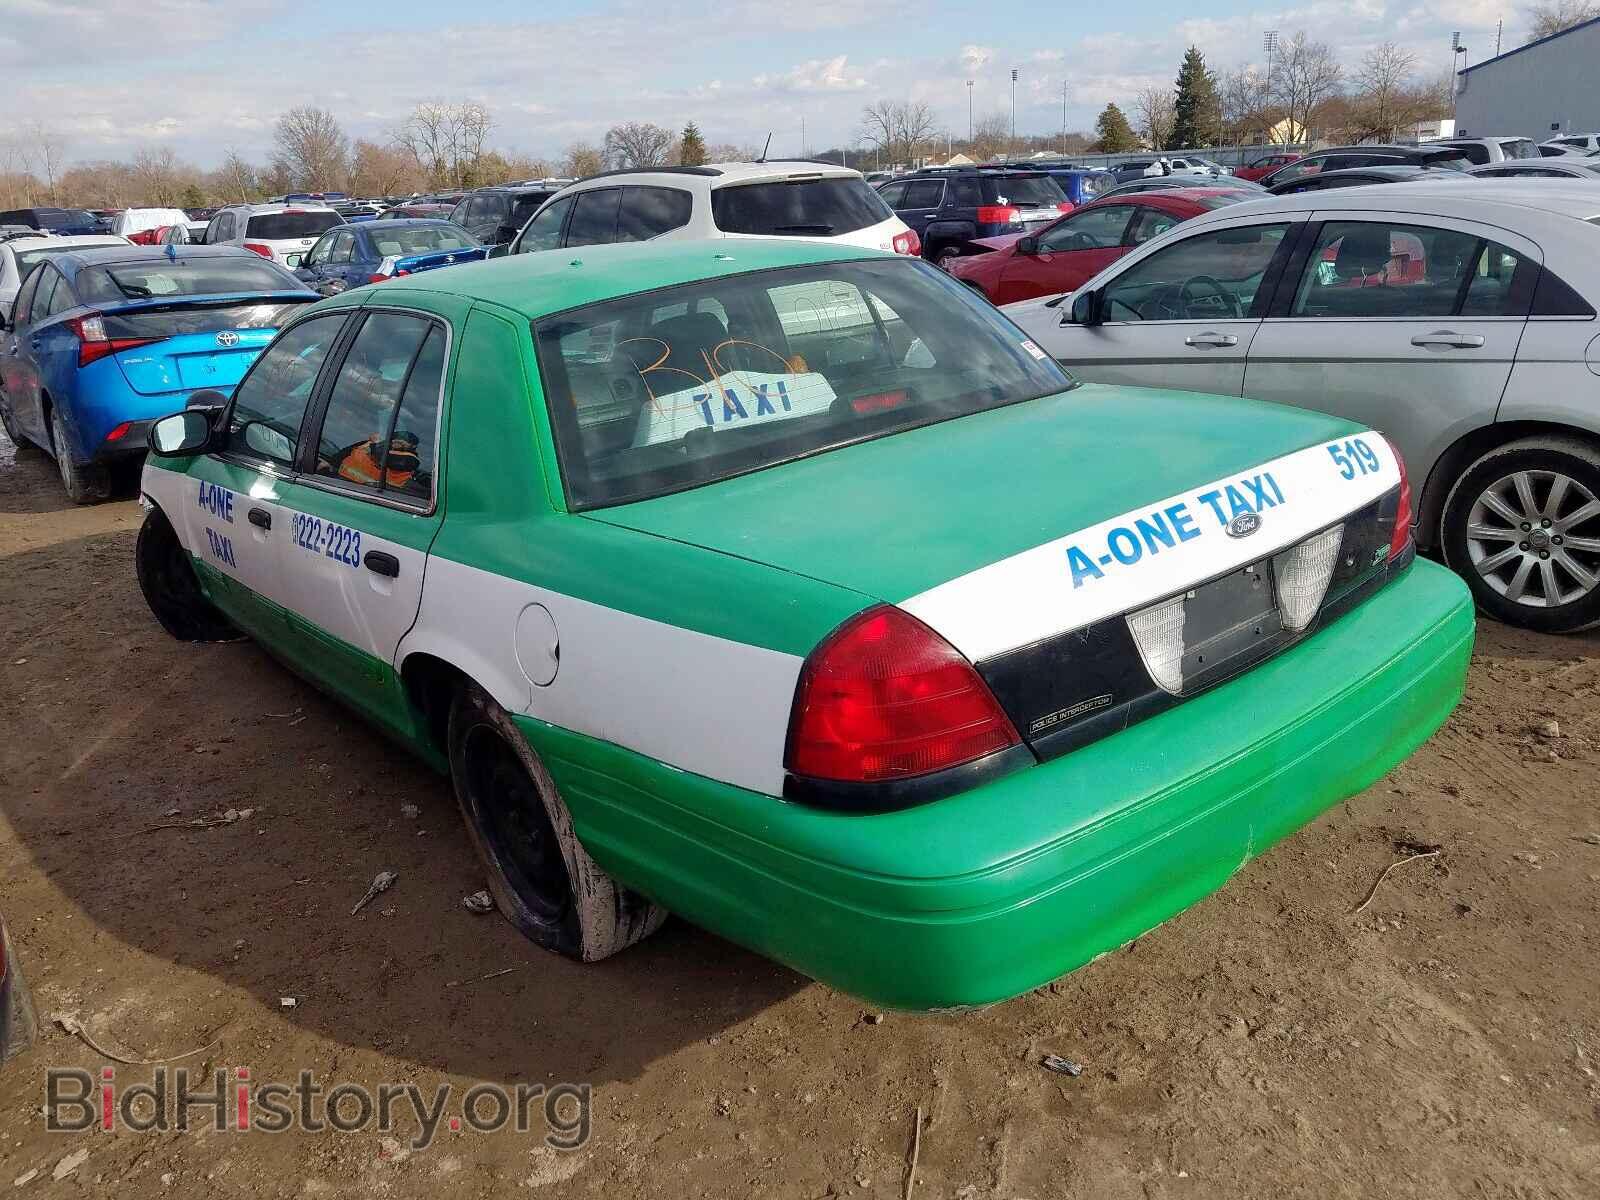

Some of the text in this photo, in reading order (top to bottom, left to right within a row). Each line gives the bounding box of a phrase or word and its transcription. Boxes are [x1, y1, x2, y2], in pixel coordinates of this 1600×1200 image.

[692, 380, 792, 426] TAXI
[1326, 438, 1380, 481] 519
[198, 480, 235, 525] A-ONE
[205, 526, 237, 569] TAXI
[296, 514, 361, 569] 222-2223
[1065, 472, 1286, 590] A-ONE TAXI
[1031, 714, 1059, 732] POLICE
